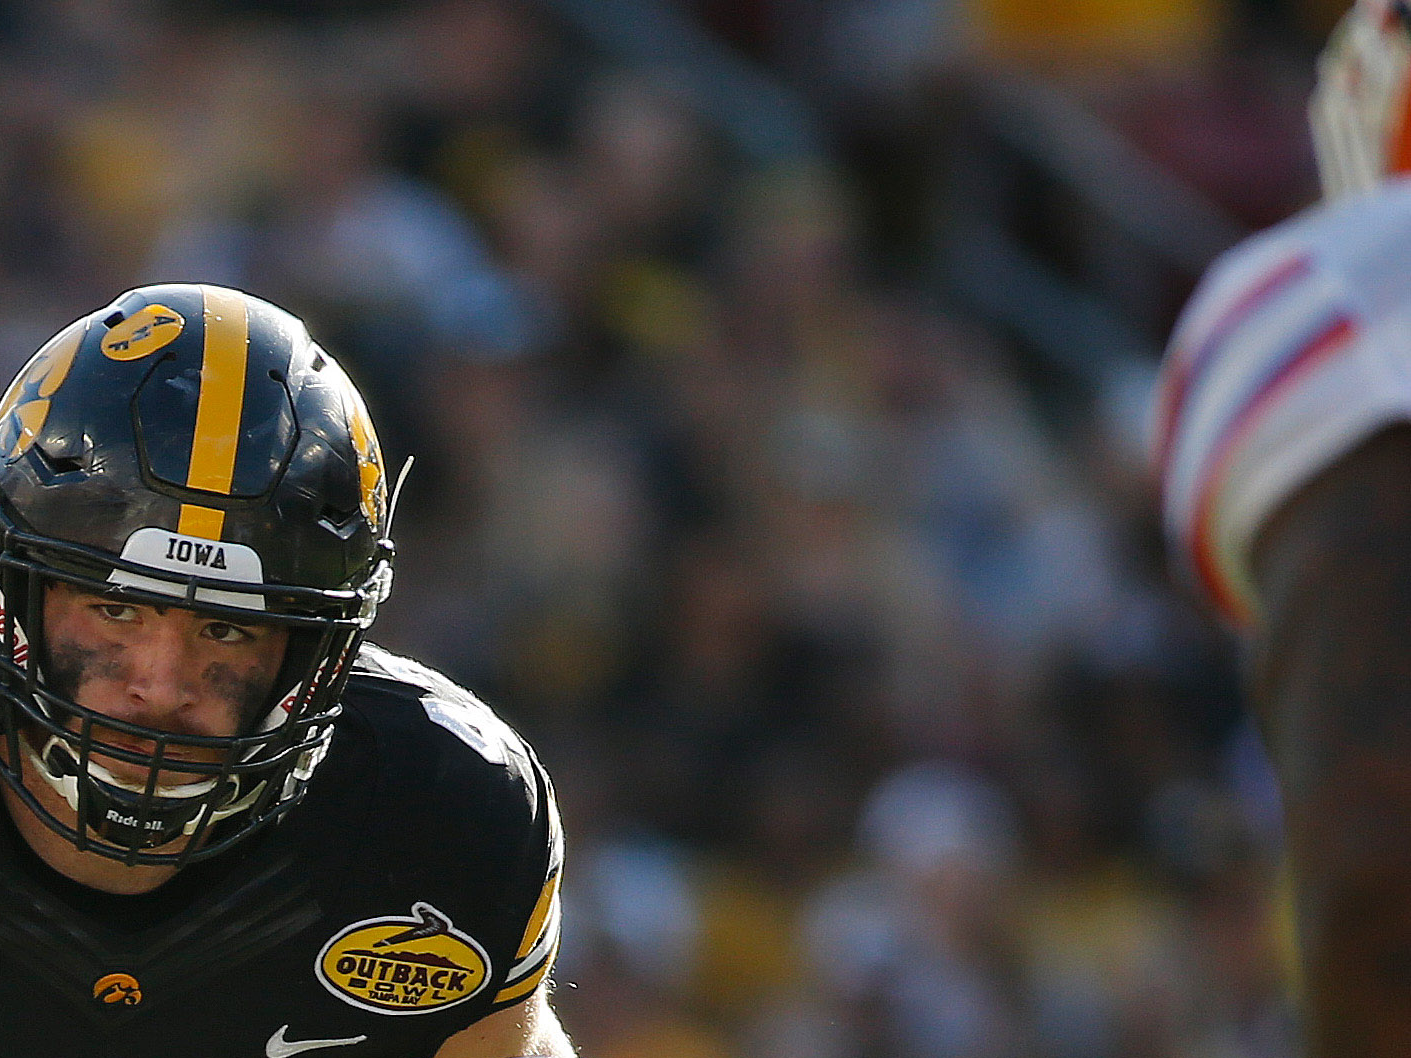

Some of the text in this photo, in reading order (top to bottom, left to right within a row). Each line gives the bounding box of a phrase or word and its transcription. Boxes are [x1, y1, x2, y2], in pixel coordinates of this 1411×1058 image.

[165, 537, 226, 570] IOWA
[337, 956, 468, 991] OUTBACK
[349, 978, 446, 1000] BOWL
